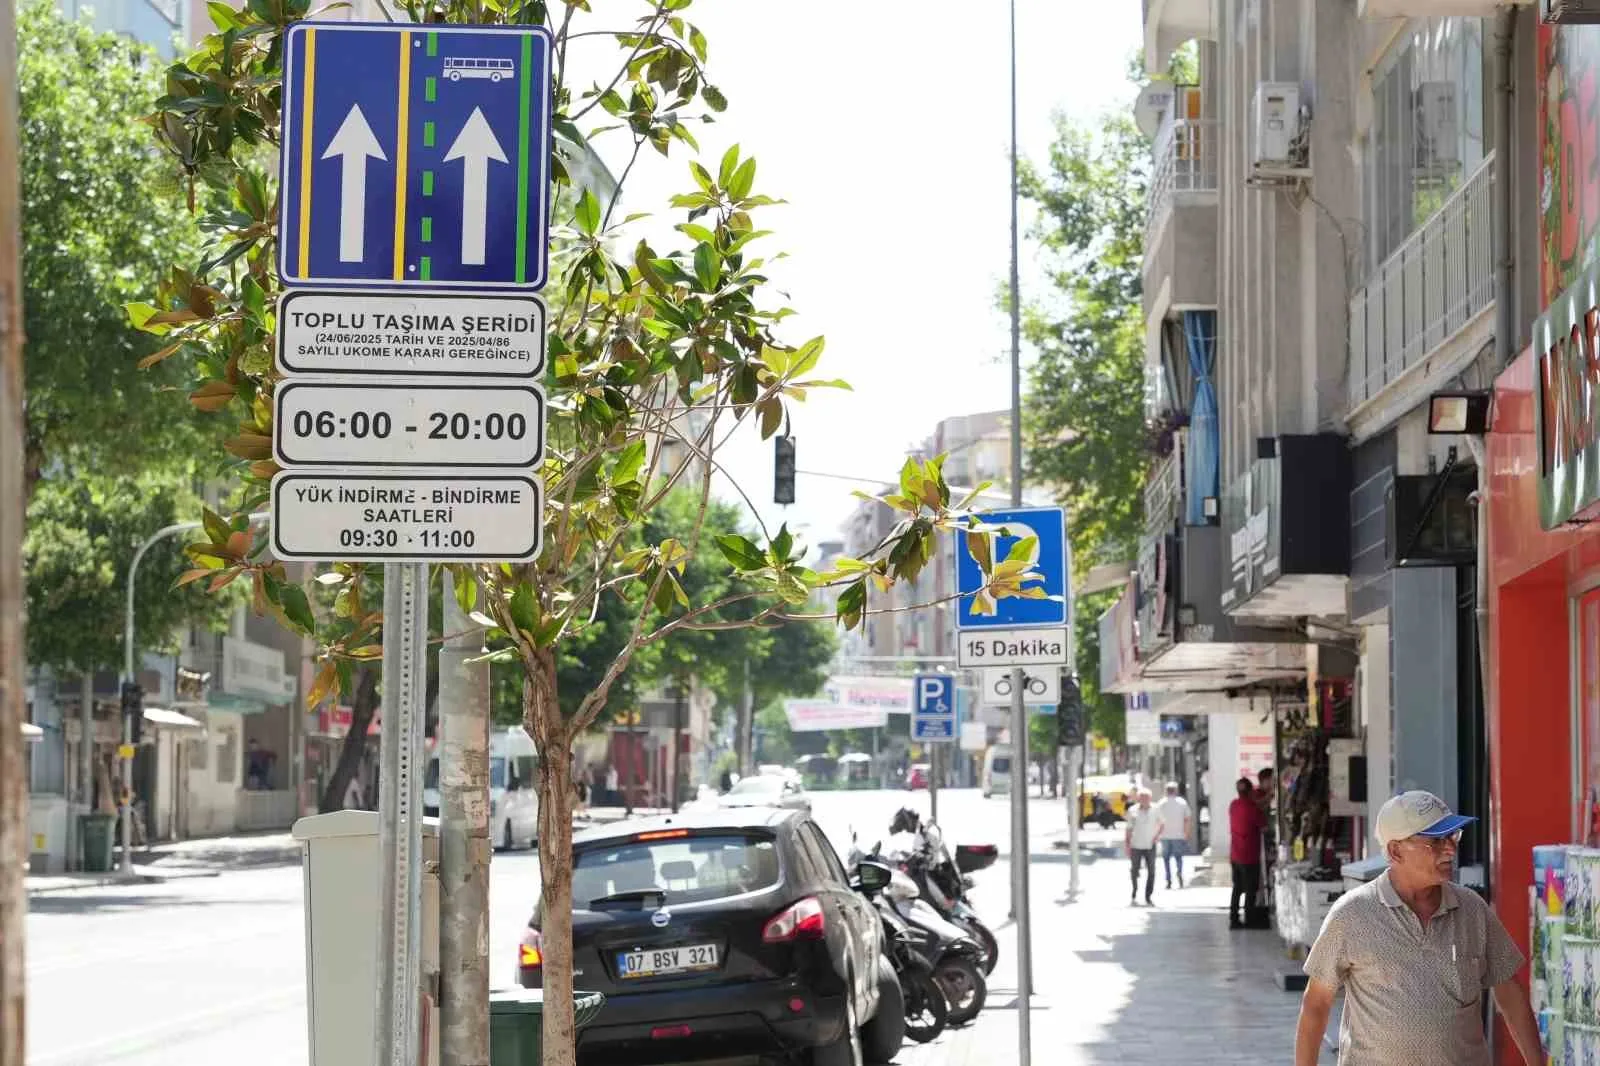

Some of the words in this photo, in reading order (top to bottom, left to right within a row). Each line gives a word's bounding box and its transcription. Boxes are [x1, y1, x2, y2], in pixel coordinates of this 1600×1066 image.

[291, 312, 365, 329] TOPLU
[372, 314, 456, 334] TAŞIMA
[461, 313, 535, 335] ŞERİDİ
[315, 333, 382, 345] (24/06/2025
[385, 334, 424, 345] TARİH
[427, 335, 444, 346] VE
[448, 336, 510, 348] 2025/04/86
[298, 345, 339, 356] SAYILI
[343, 346, 391, 357] UKOME
[394, 347, 445, 358] KARARI
[448, 347, 530, 362] GEREĞİNCE)
[293, 410, 392, 439] 06:00
[428, 412, 526, 441] 20:00
[295, 485, 333, 503] YÜK
[338, 485, 415, 504] İNDİRME
[432, 486, 521, 504] BİNDİRME
[363, 507, 453, 523] SAATLERİ
[340, 529, 398, 548] 09:30
[419, 529, 475, 548] 11:00
[968, 640, 985, 657] 15
[992, 639, 1061, 657] Dakika
[921, 678, 944, 710] P
[627, 954, 644, 971] 07
[653, 950, 680, 969] BSV
[688, 946, 715, 964] 321
